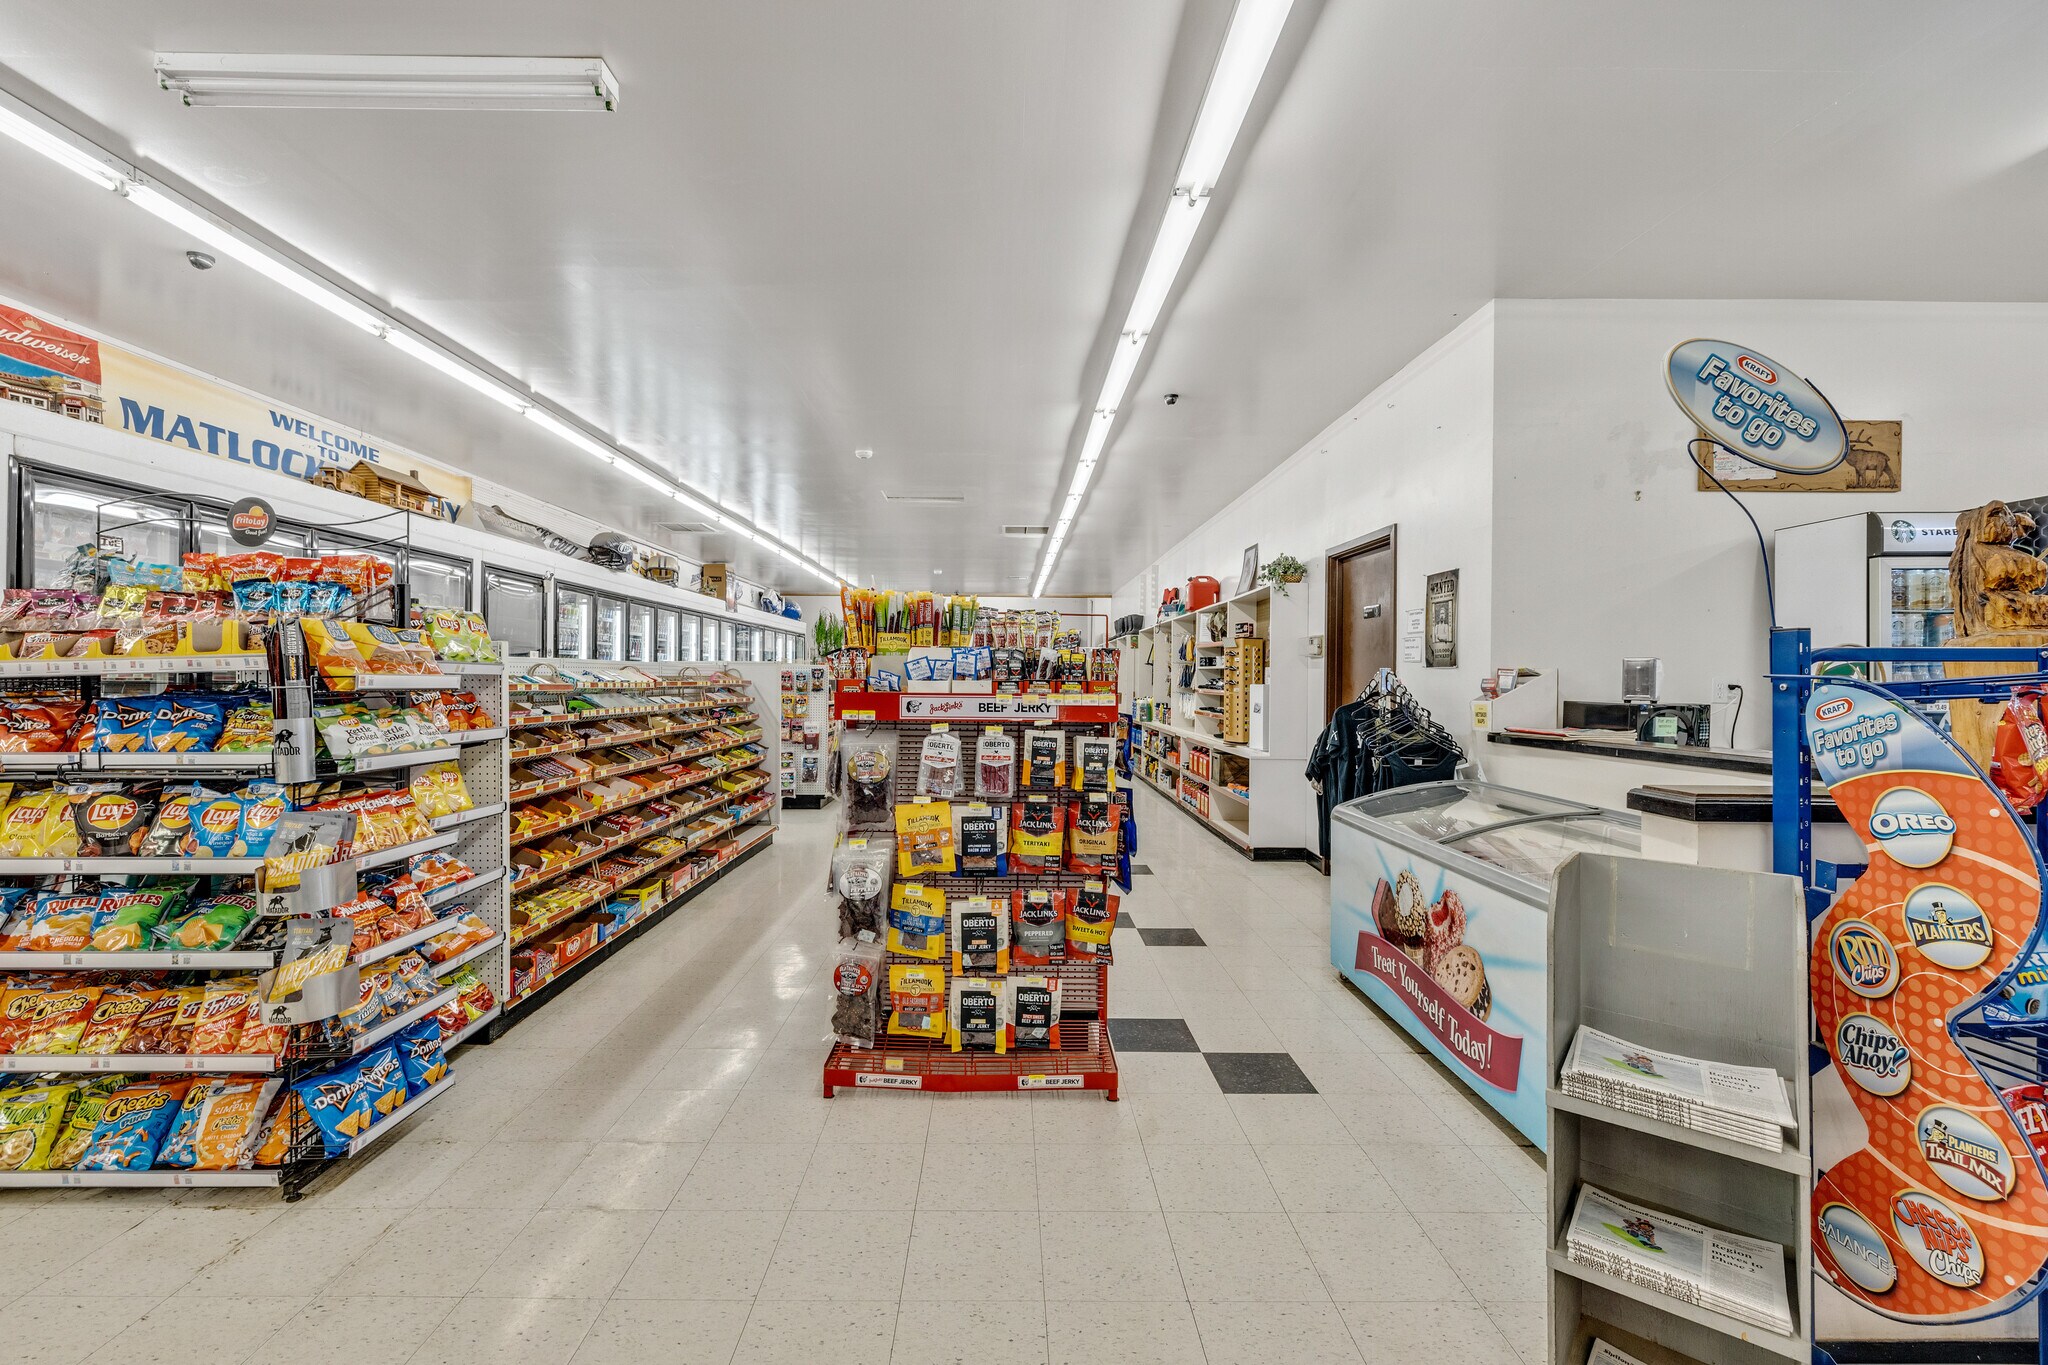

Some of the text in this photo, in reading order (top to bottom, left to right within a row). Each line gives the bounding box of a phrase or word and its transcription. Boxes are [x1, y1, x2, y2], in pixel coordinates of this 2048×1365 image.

[1745, 361, 1770, 378] KRAFT
[1699, 356, 1817, 437] Favorites
[1714, 396, 1783, 446] to go
[119, 396, 325, 479] MATLOCK
[269, 410, 379, 463] WELCOME
[317, 445, 340, 462] TO
[1921, 528, 1959, 536] STARB
[1804, 689, 1809, 697] 9
[156, 708, 215, 722] Doritos
[979, 703, 1008, 712] BEEF
[1014, 703, 1052, 713] JERKY
[1822, 702, 1846, 716] KRAFT
[346, 726, 373, 737] Kettle
[347, 733, 379, 744] Cooked
[1813, 713, 1897, 753] Favorites
[1804, 754, 1809, 762] 6
[1836, 739, 1885, 766] to go
[91, 801, 135, 820] Lay's
[963, 822, 995, 831] OBERTO
[1019, 820, 1036, 828] JACK
[1076, 819, 1091, 828] JACK
[1804, 819, 1809, 827] 3
[1872, 814, 1955, 834] OREO
[96, 831, 129, 839] Barbecue
[48, 896, 100, 914] RUFFL
[98, 894, 163, 913] RUFFLES
[902, 897, 932, 910] TILLAMOOK
[1073, 905, 1088, 915] JACK
[1020, 910, 1036, 918] JACK
[963, 919, 995, 927] OBERTO
[1072, 925, 1089, 934] SWEET
[1914, 922, 1987, 942] PLANTERS
[1838, 935, 1890, 969] RITZ
[900, 978, 933, 987] TILLAMOOK
[1851, 964, 1884, 986] Chips
[963, 997, 995, 1006] OBERTO
[1018, 993, 1050, 1002] OBERTO
[32, 994, 89, 1022] Cheetos
[91, 997, 151, 1023] Cheetos
[201, 993, 249, 1022] Fritos
[1372, 945, 1493, 1069] Treat Yourself Today!
[1843, 1023, 1898, 1052] Chips
[410, 1037, 442, 1059] Doritos
[1843, 1044, 1909, 1074] Ahoy!
[1566, 1071, 1598, 1087] Shelton
[1577, 1069, 1610, 1083] Shelton
[1610, 1077, 1638, 1091] YMCA
[1639, 1085, 1668, 1098] opens
[1668, 1092, 1699, 1106] March
[314, 1078, 364, 1110] Doritos
[102, 1090, 171, 1124] Cheetos
[213, 1102, 253, 1116] SIMPLY
[211, 1115, 244, 1132] Cheetos
[1948, 1135, 1997, 1162] PLANTERS
[1926, 1142, 2003, 1192] TRAIL MIX
[1572, 1244, 1607, 1261] Shelton
[1712, 1242, 1752, 1259] Region
[1818, 1216, 1889, 1276] BALANCE
[1572, 1238, 1605, 1255] Shelton
[1606, 1250, 1632, 1264] YMCA
[1633, 1261, 1661, 1276] opens
[1663, 1271, 1693, 1286] March
[1711, 1249, 1748, 1265] moves
[1711, 1255, 1745, 1270] Phase
[1929, 1249, 1981, 1284] Chips
